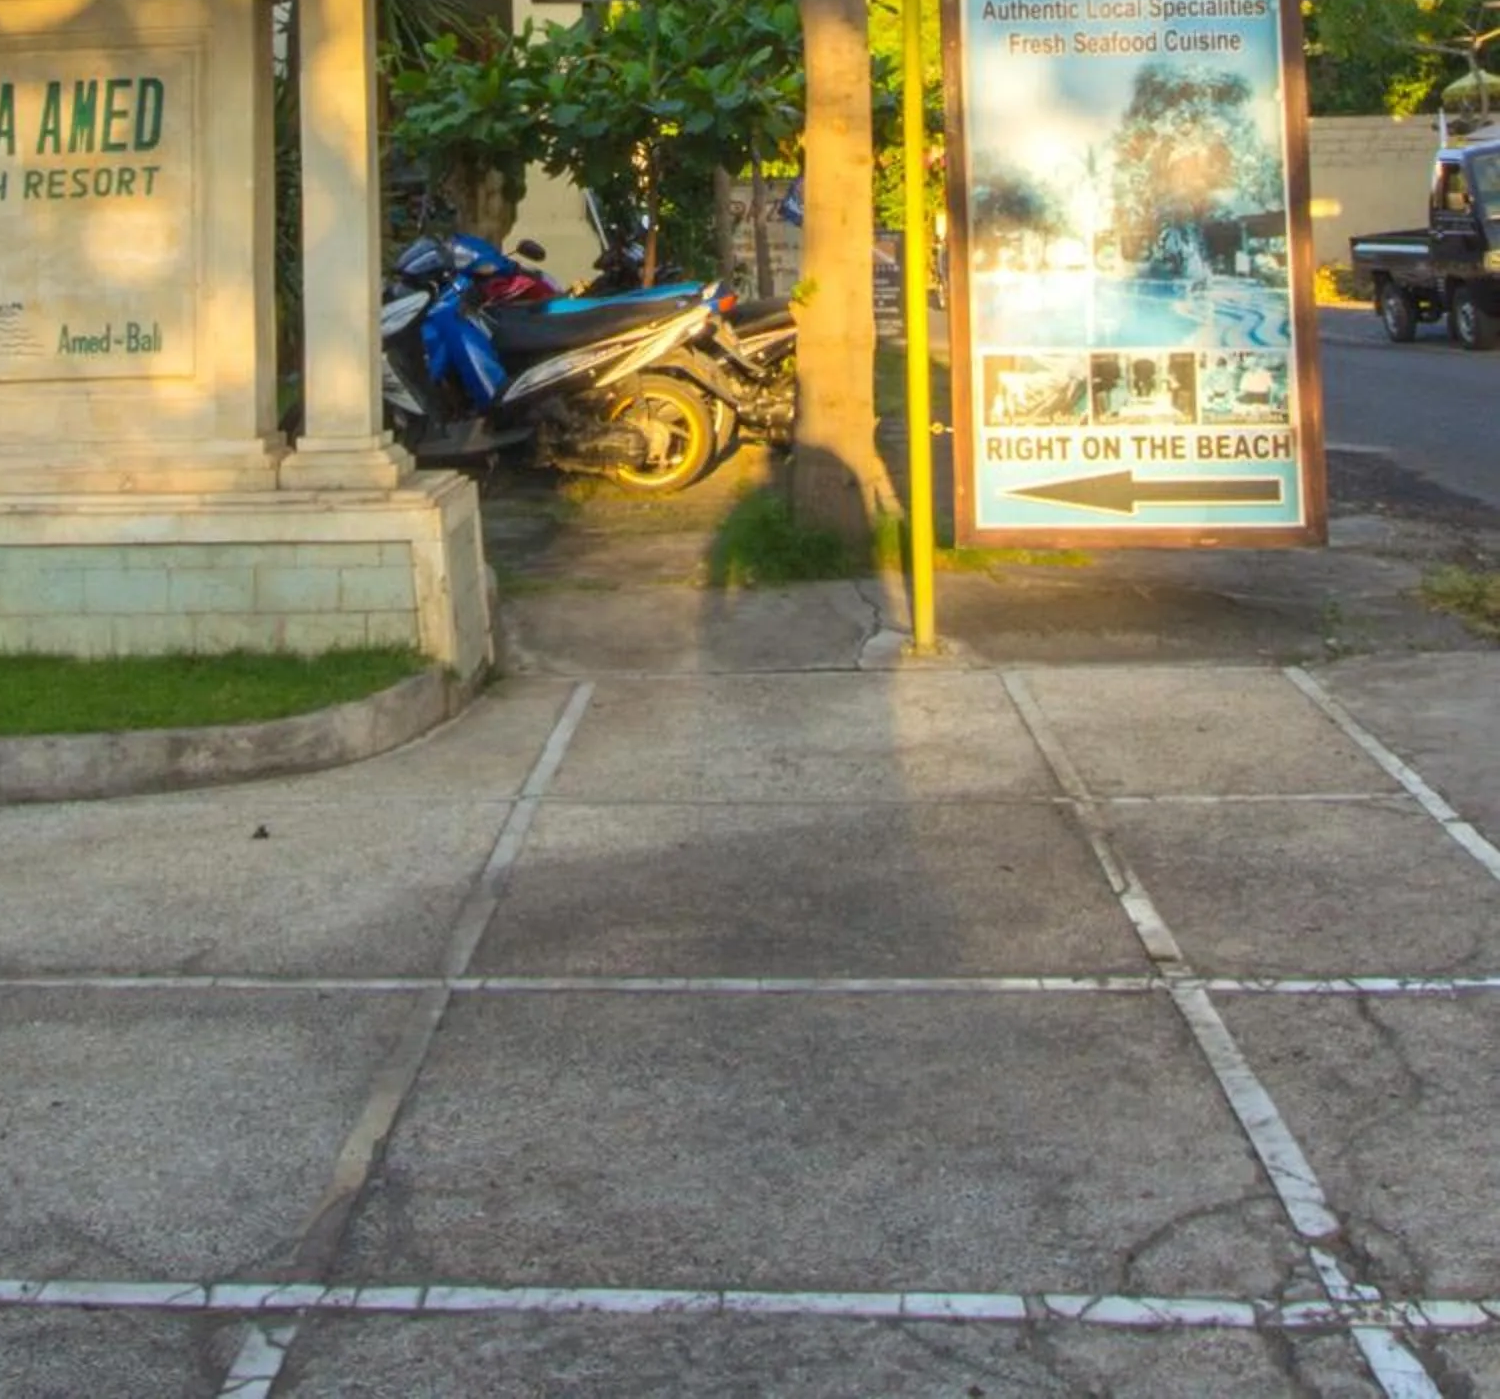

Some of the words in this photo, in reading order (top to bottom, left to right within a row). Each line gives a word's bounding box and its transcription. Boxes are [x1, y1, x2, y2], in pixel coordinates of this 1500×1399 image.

[982, 0, 1079, 21] Authentic
[1087, 0, 1142, 20] Local
[1009, 32, 1066, 55] Fresh
[1074, 31, 1158, 54] Seafood
[1164, 29, 1242, 52] Cuisine
[36, 77, 165, 155] AMED
[23, 166, 160, 200] RESORT
[986, 437, 1072, 461] RIGHT
[1082, 436, 1121, 460] ON
[1131, 436, 1186, 460] THE
[1197, 434, 1292, 460] BEACH
